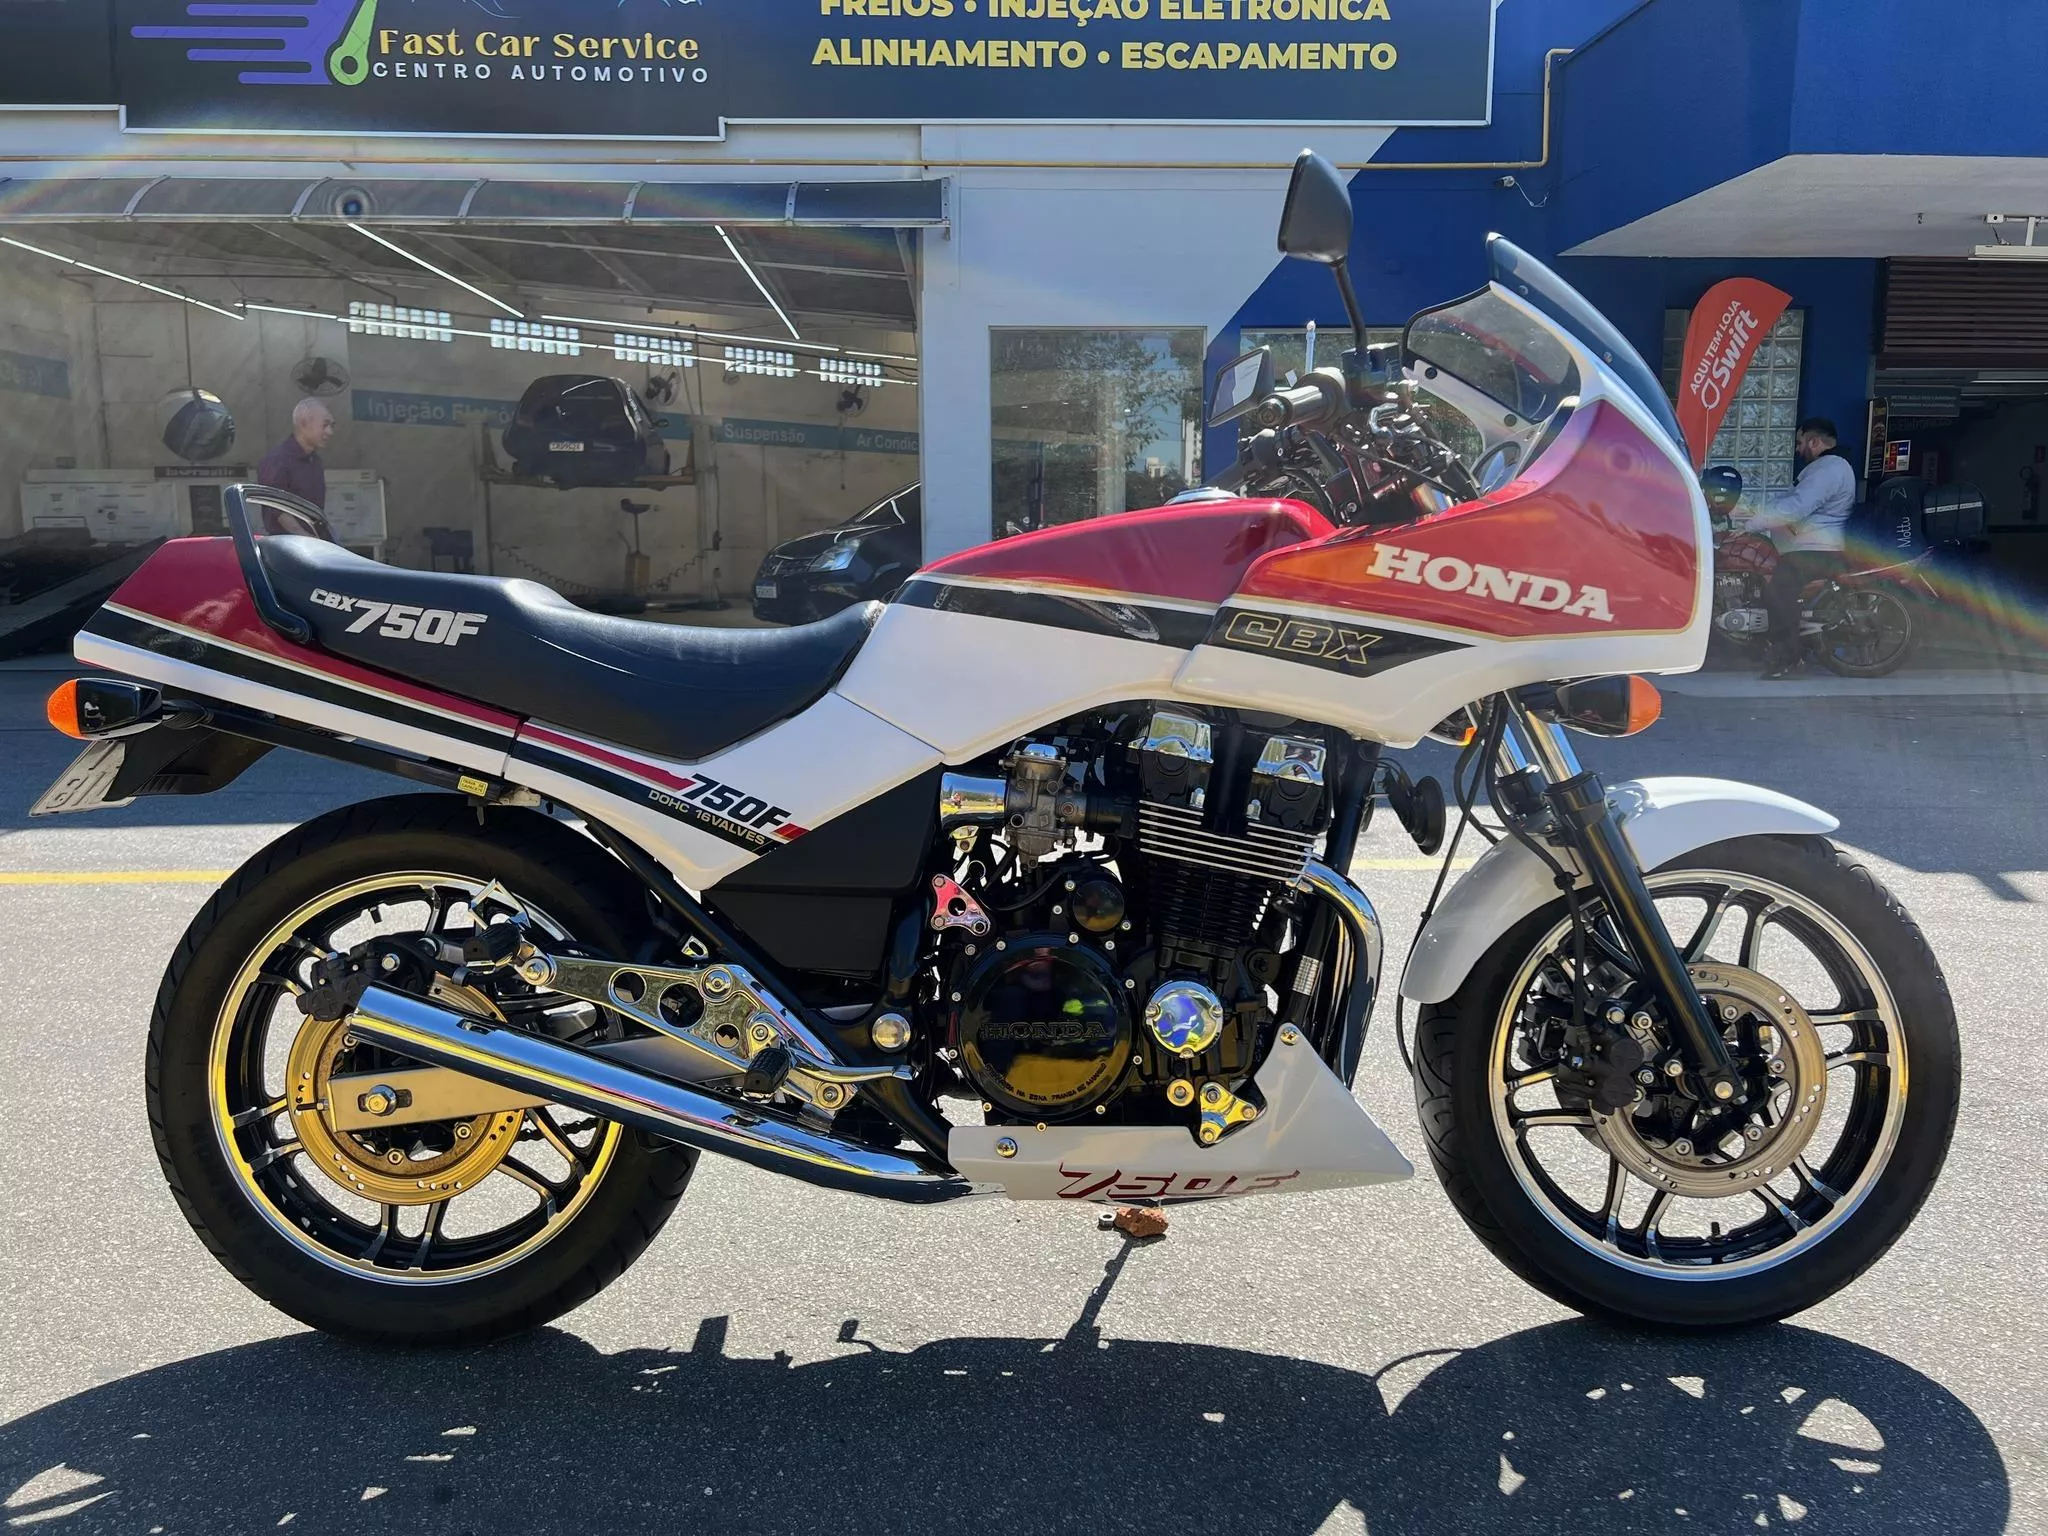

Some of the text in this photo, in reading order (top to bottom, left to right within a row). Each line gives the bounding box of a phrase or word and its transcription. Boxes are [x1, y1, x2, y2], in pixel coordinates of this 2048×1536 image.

[820, 0, 954, 17] FREIOS
[379, 28, 699, 60] Fast Car Service
[811, 38, 1397, 70] ALINHAMENTO ESCAPAMENTO
[372, 62, 708, 83] CENTRO AUTOMOTIVO
[1690, 300, 1741, 395] AQUI TEM LOJA
[1712, 310, 1758, 388] Swift
[368, 398, 445, 422] Injeção
[724, 423, 805, 443] Suspensão
[856, 433, 873, 448] Ar
[1896, 516, 1912, 549] Mottu
[1366, 542, 1614, 622] HONDA
[309, 587, 488, 646] CBX 750F
[1225, 612, 1382, 665] CBX
[648, 789, 690, 813] DOHC
[681, 773, 792, 829] 750F
[980, 1021, 1109, 1041] HONDA
[1056, 1162, 1300, 1200] 750F
